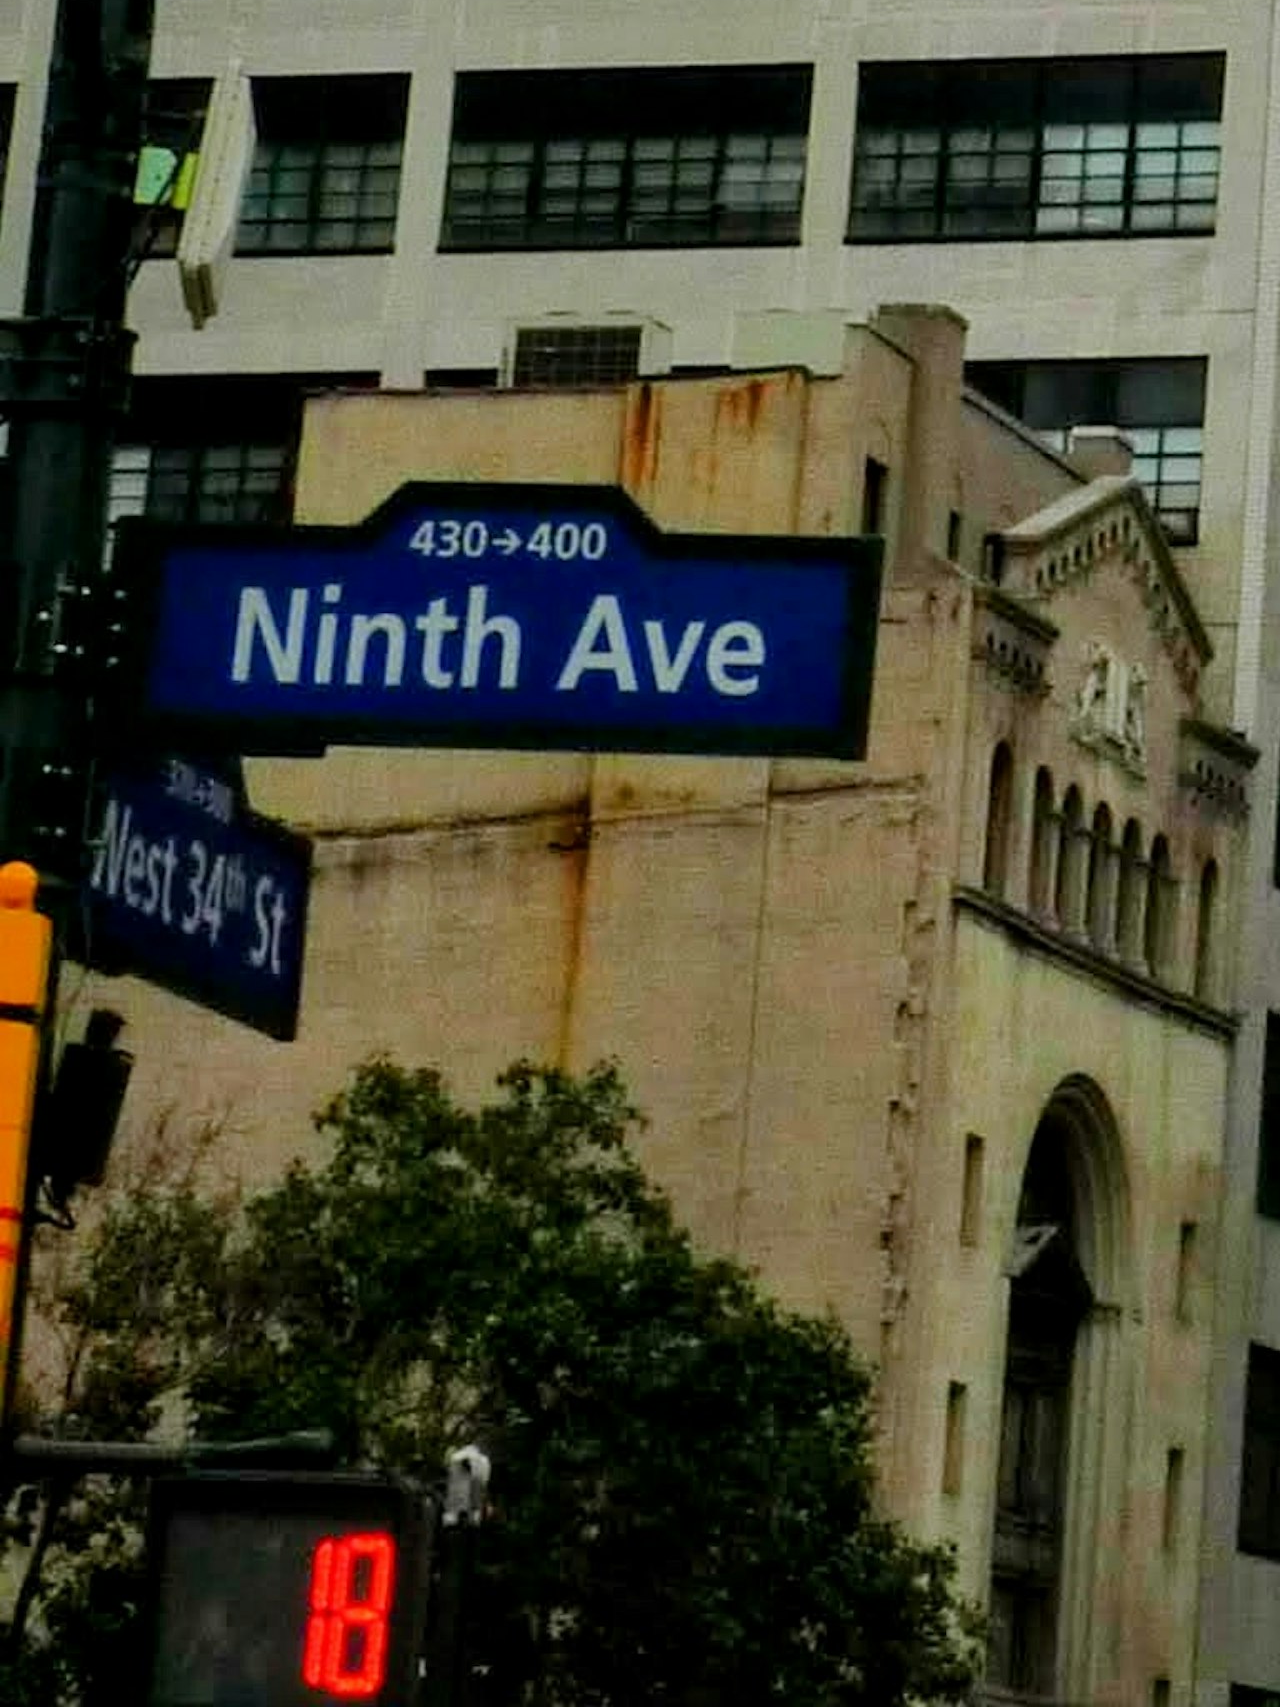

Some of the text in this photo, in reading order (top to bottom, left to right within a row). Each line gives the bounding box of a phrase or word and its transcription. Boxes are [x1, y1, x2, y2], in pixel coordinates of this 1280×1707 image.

[409, 519, 607, 561] 430 400
[230, 584, 766, 697] Ninth Ave
[250, 876, 284, 975] St
[303, 1529, 397, 1698] 18
